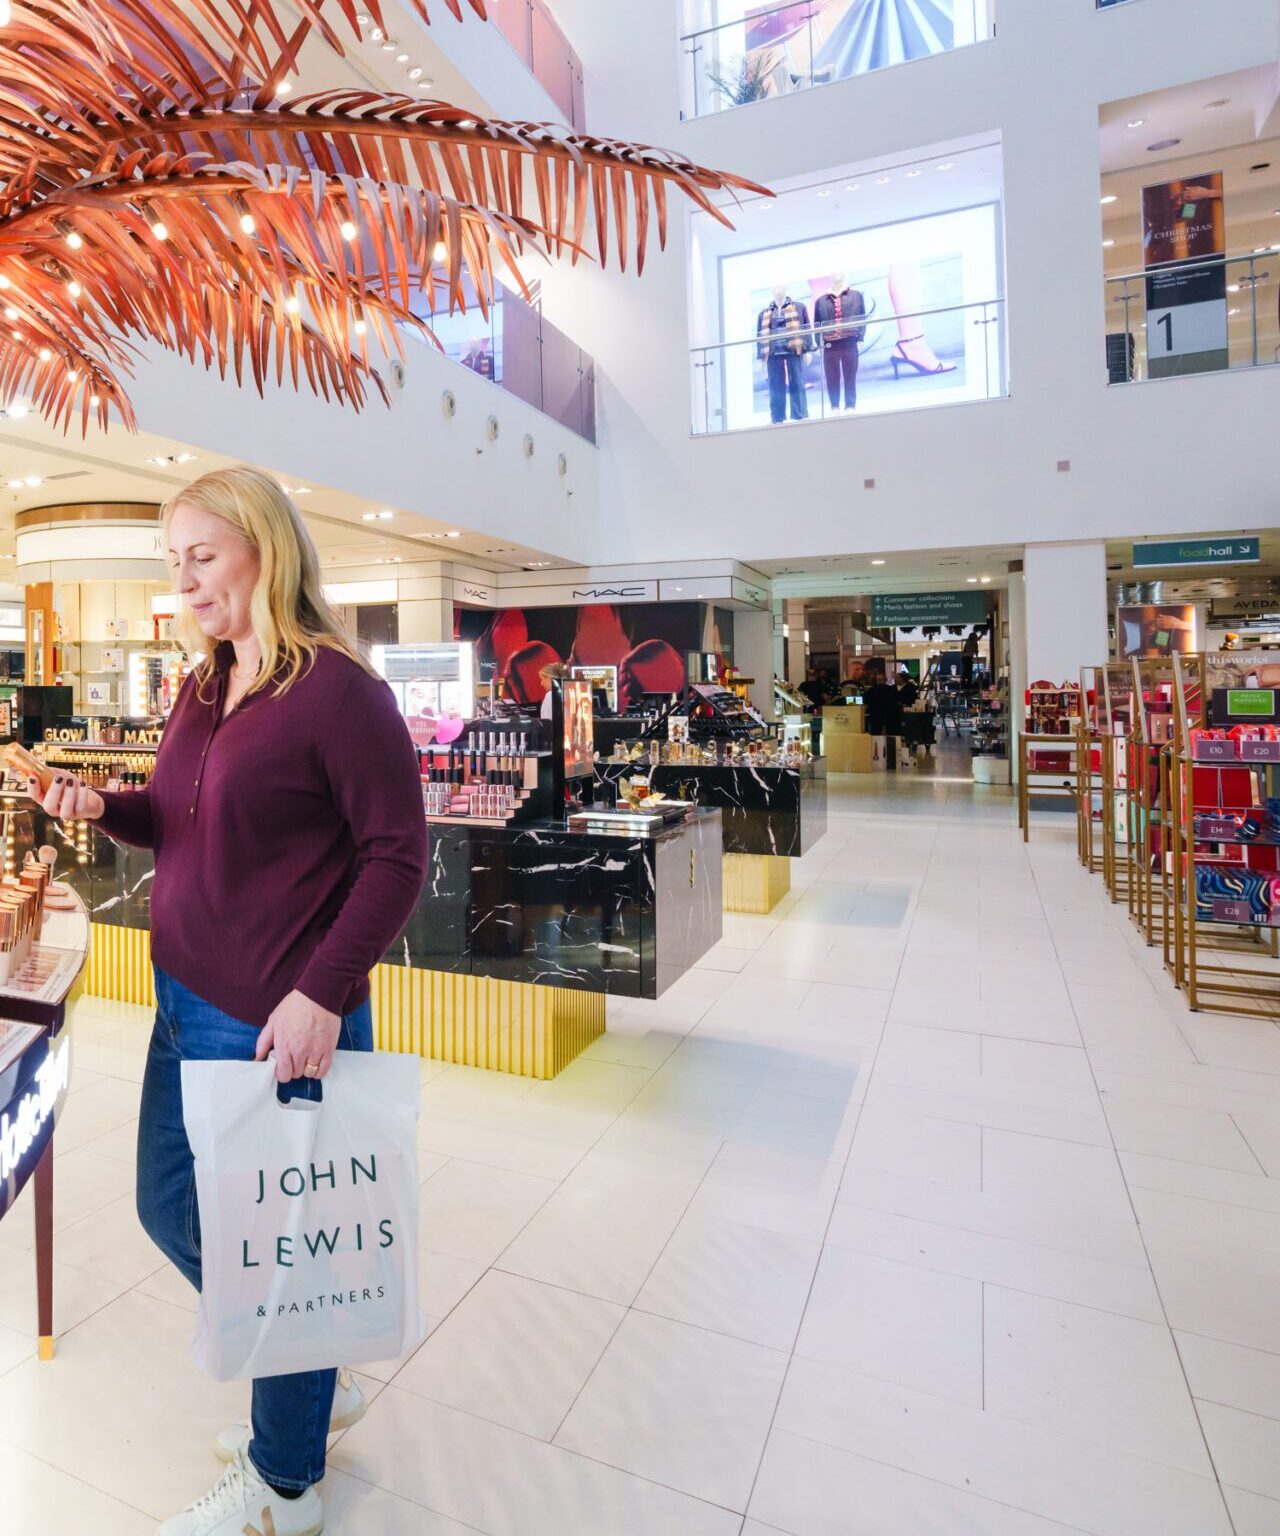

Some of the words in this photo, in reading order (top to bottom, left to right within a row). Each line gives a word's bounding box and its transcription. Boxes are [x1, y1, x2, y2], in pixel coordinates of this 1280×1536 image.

[1154, 223, 1213, 240] CHRISTMAS
[1169, 233, 1198, 243] SHOP
[1157, 312, 1173, 351] 1
[1234, 600, 1280, 609] AVEDA
[45, 728, 85, 742] GLOW
[255, 1154, 377, 1204] JOHN
[242, 1219, 394, 1267] LEWIS
[257, 1305, 266, 1317] &
[277, 1286, 385, 1316] PARTNERS
